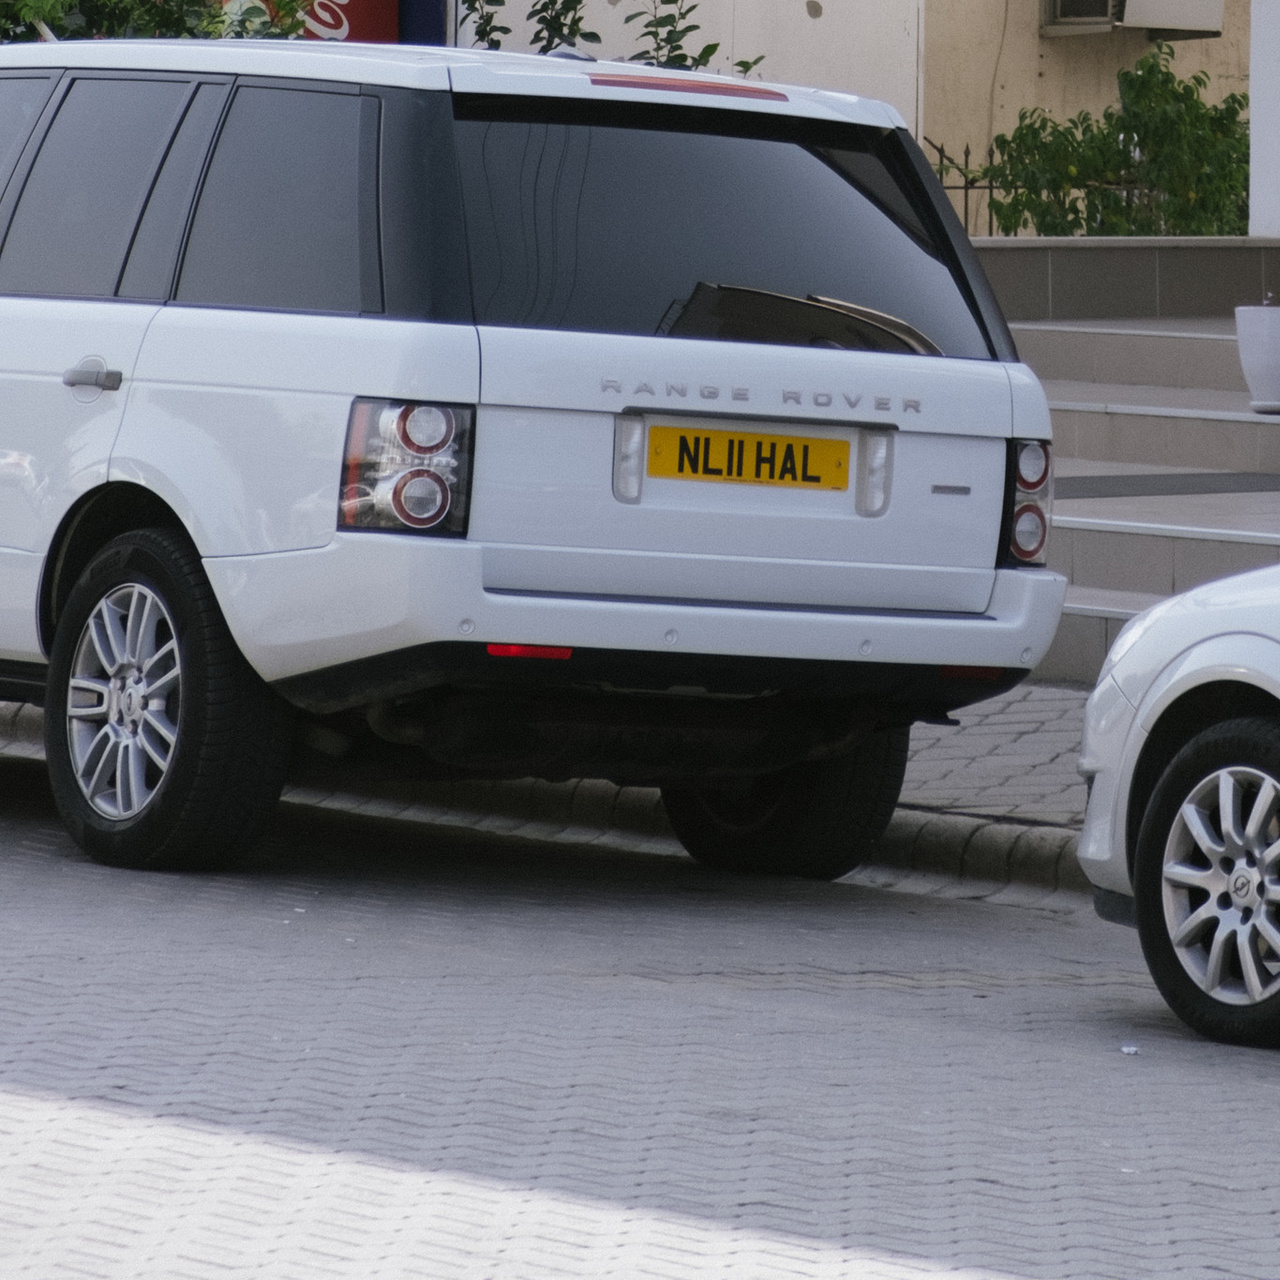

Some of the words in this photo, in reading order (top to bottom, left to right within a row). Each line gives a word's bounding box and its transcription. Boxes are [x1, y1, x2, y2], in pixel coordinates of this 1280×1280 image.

[601, 379, 750, 402] RANGE
[781, 389, 922, 414] ROVER
[678, 435, 745, 478] NL11
[754, 441, 822, 483] HAL
